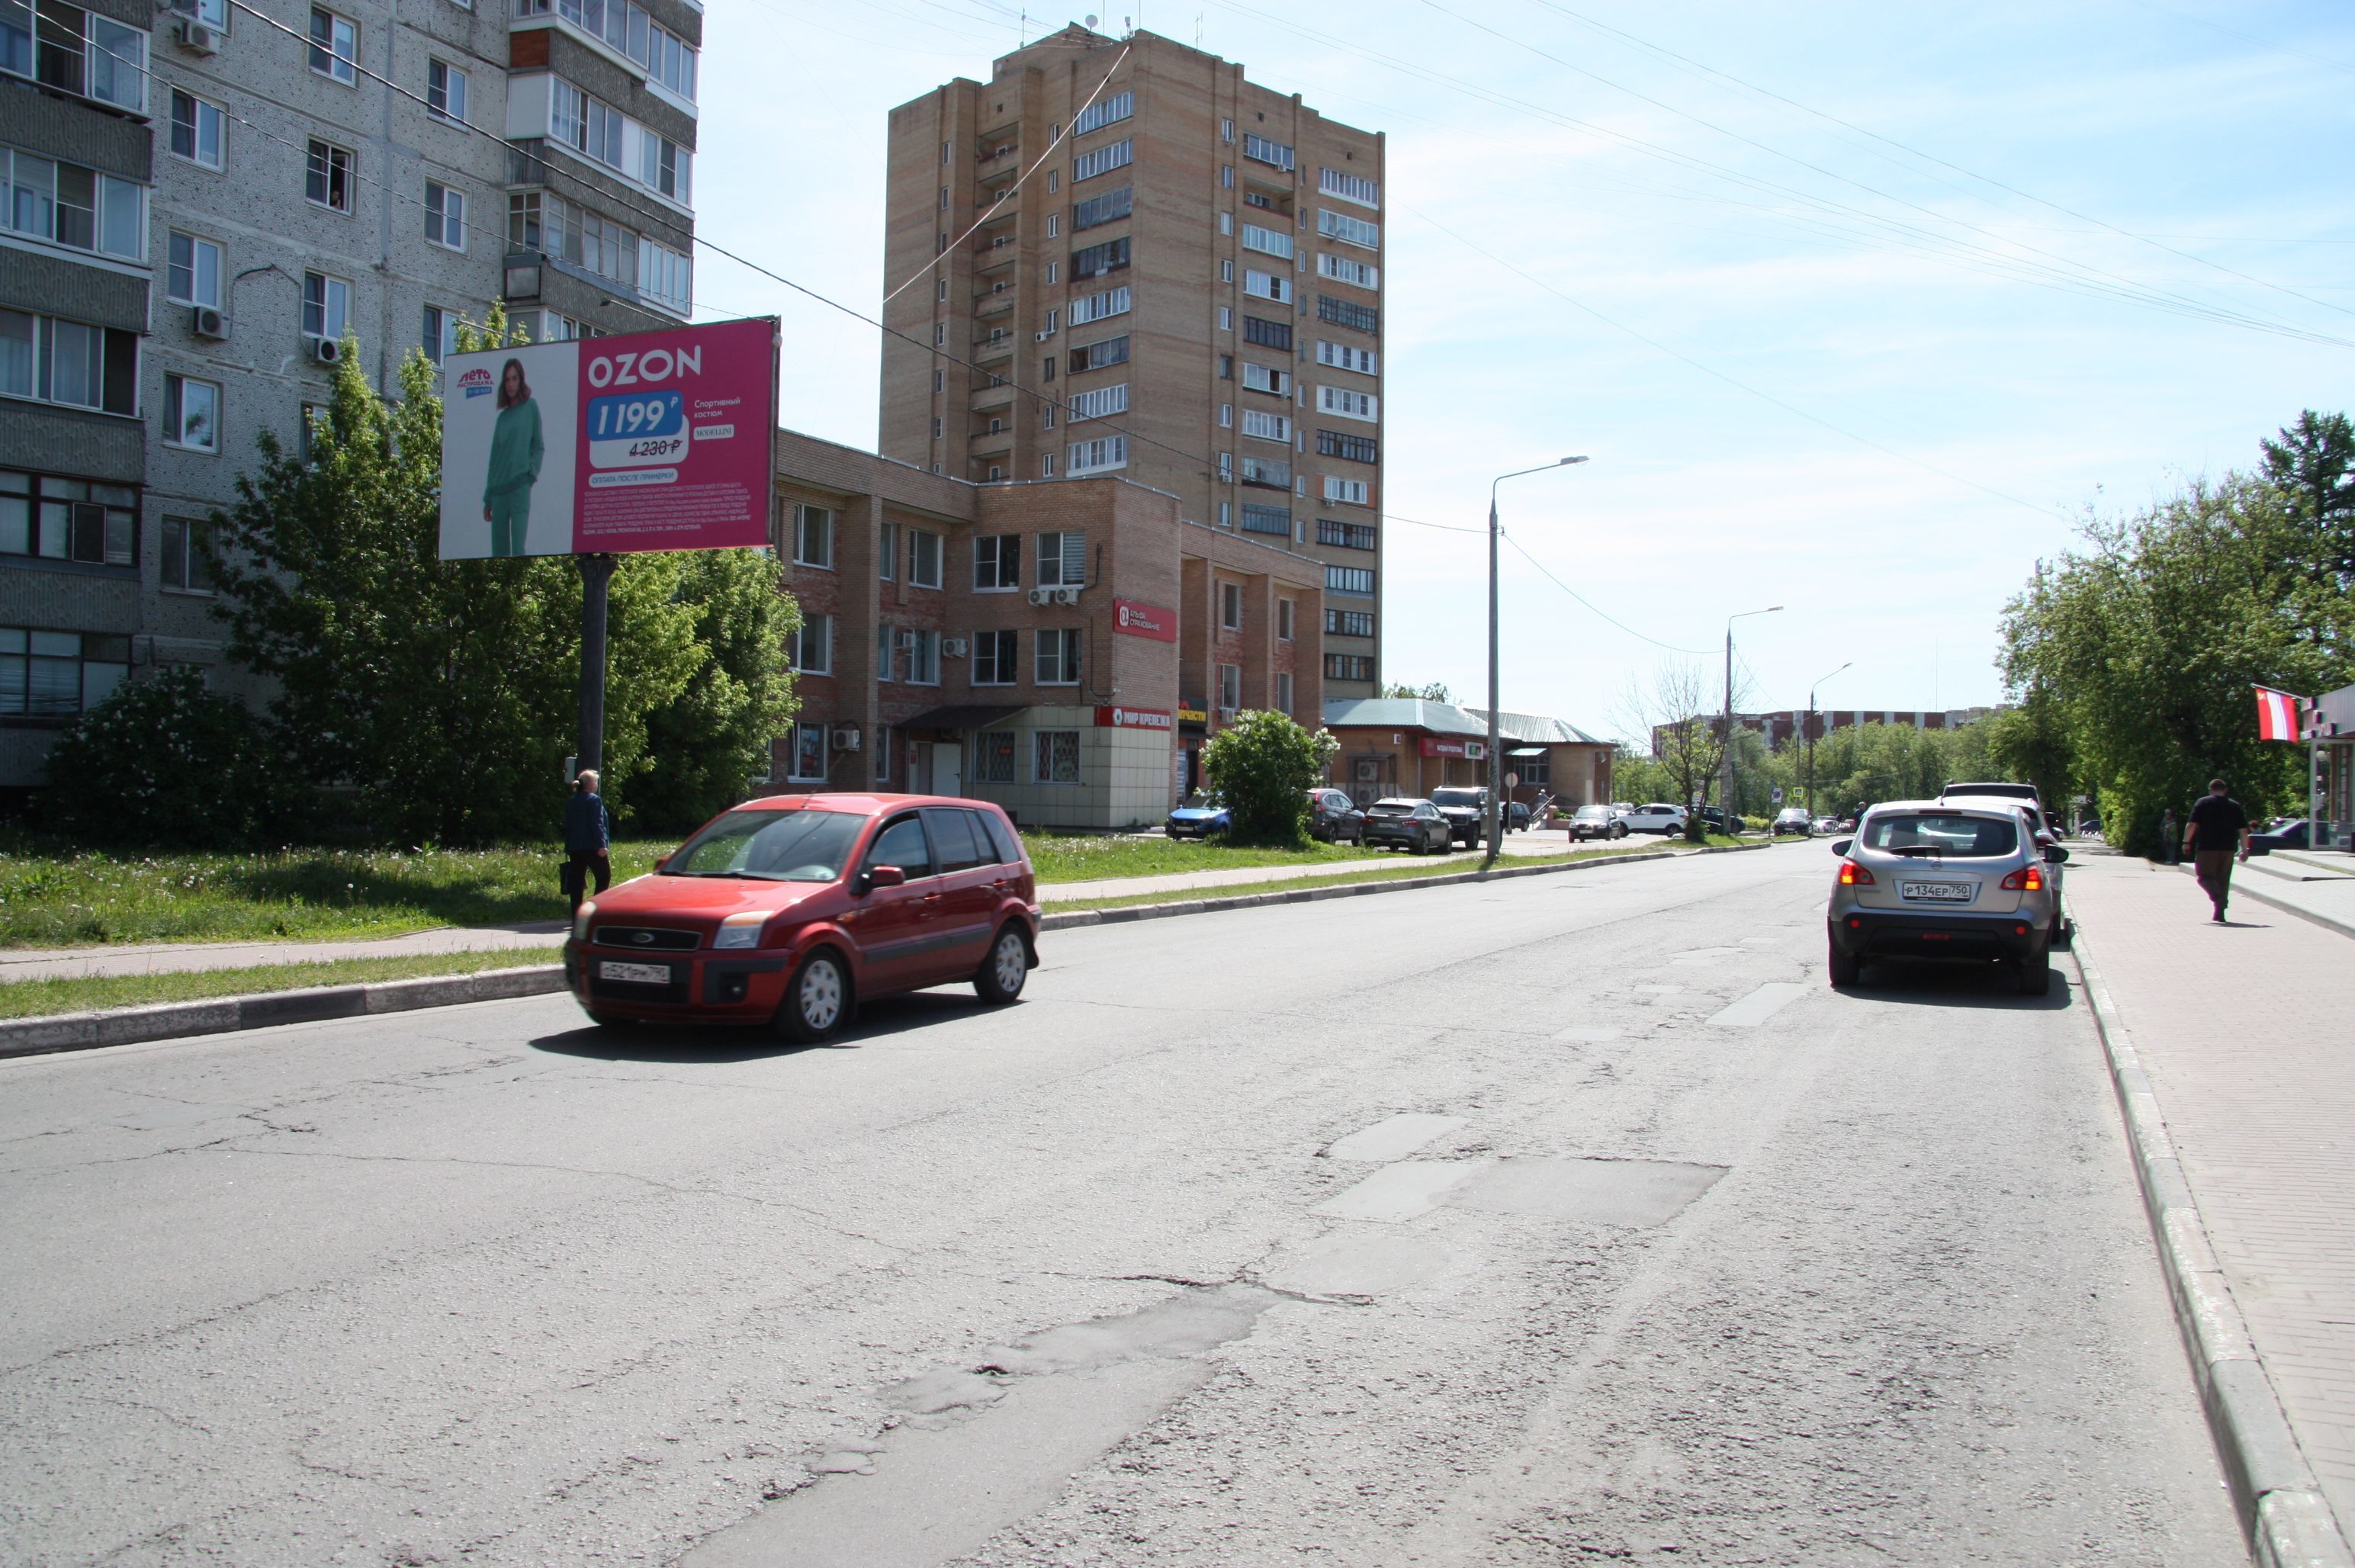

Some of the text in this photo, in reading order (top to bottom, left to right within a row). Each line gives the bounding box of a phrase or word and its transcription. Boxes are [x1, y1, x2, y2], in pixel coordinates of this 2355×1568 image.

[588, 345, 701, 388] OZON
[695, 397, 741, 409] Спортивный
[696, 427, 732, 436] MODELLINI
[592, 471, 674, 484] ОПЛАТА ПОСЛЕ ПРИМЕРКИ
[1129, 610, 1146, 619] АЛЬФА
[1129, 619, 1160, 631] СТРАХОВАНИЕ
[1123, 712, 1171, 728] МИР КРЕПЕЖА
